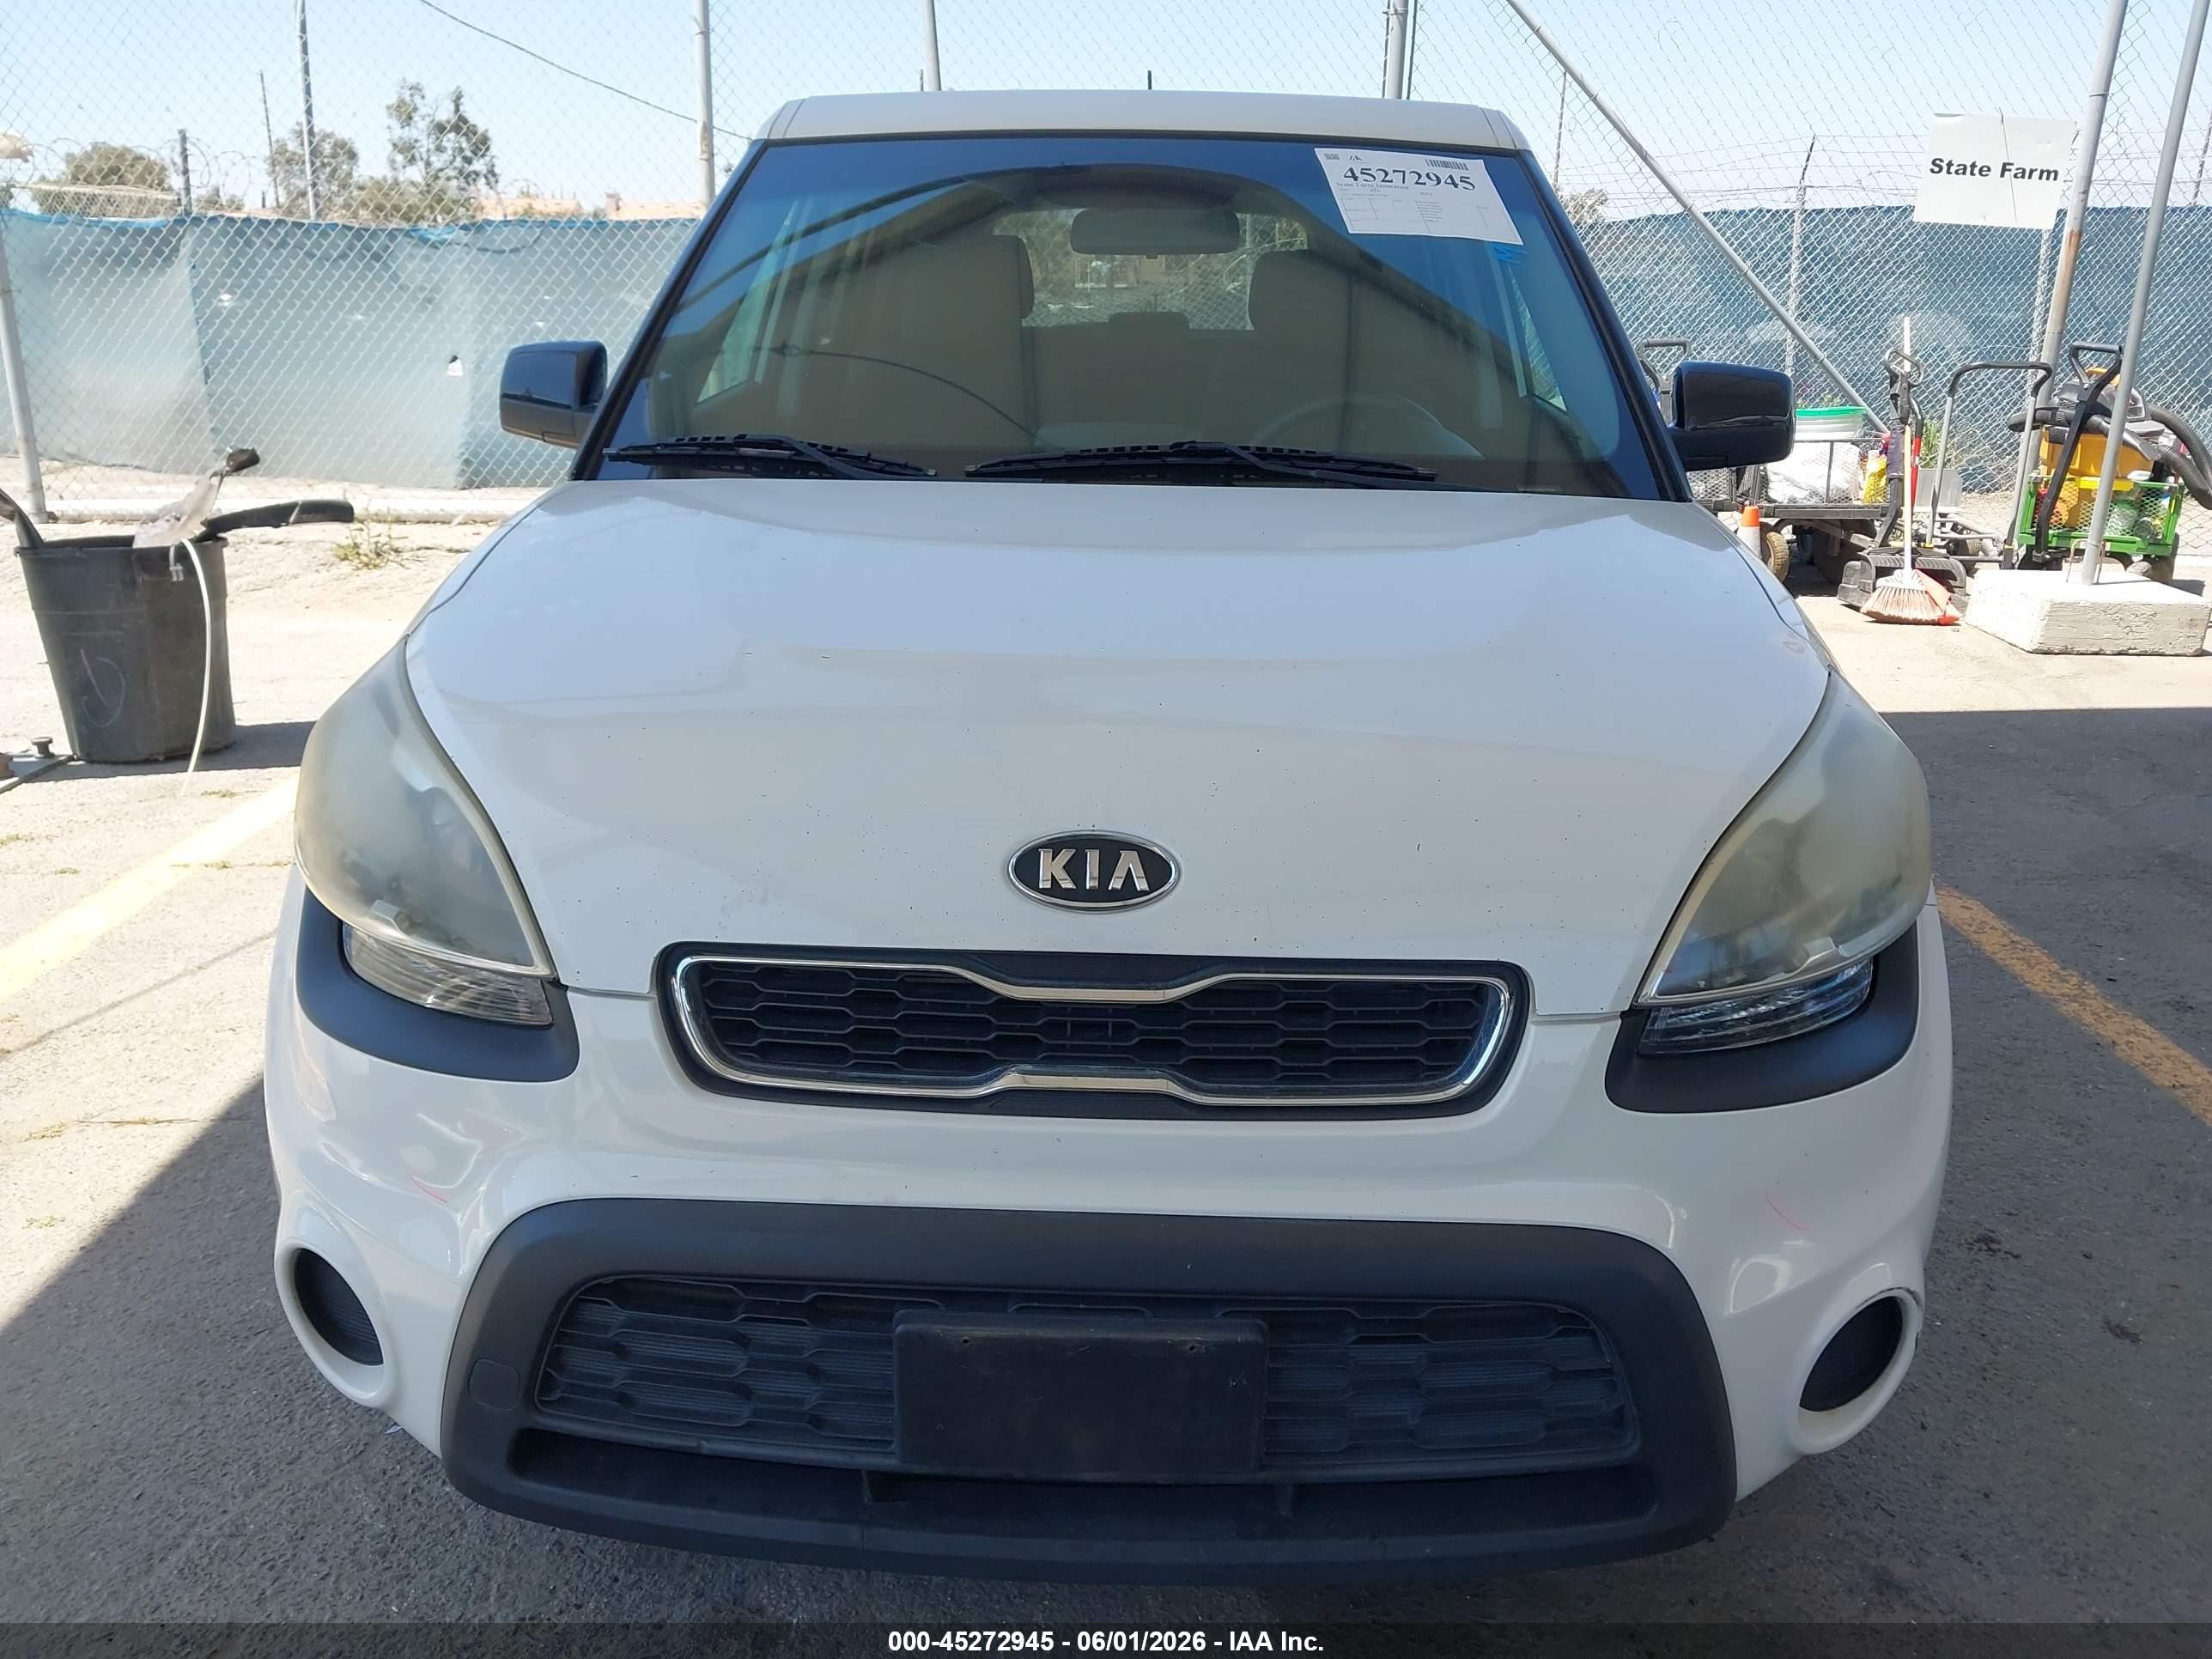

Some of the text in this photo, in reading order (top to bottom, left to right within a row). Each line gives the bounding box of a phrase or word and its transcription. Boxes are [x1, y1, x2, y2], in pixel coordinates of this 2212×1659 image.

[1343, 167, 1476, 191] 45272945
[1929, 158, 2059, 181] State Farm
[1038, 848, 1150, 891] KIA
